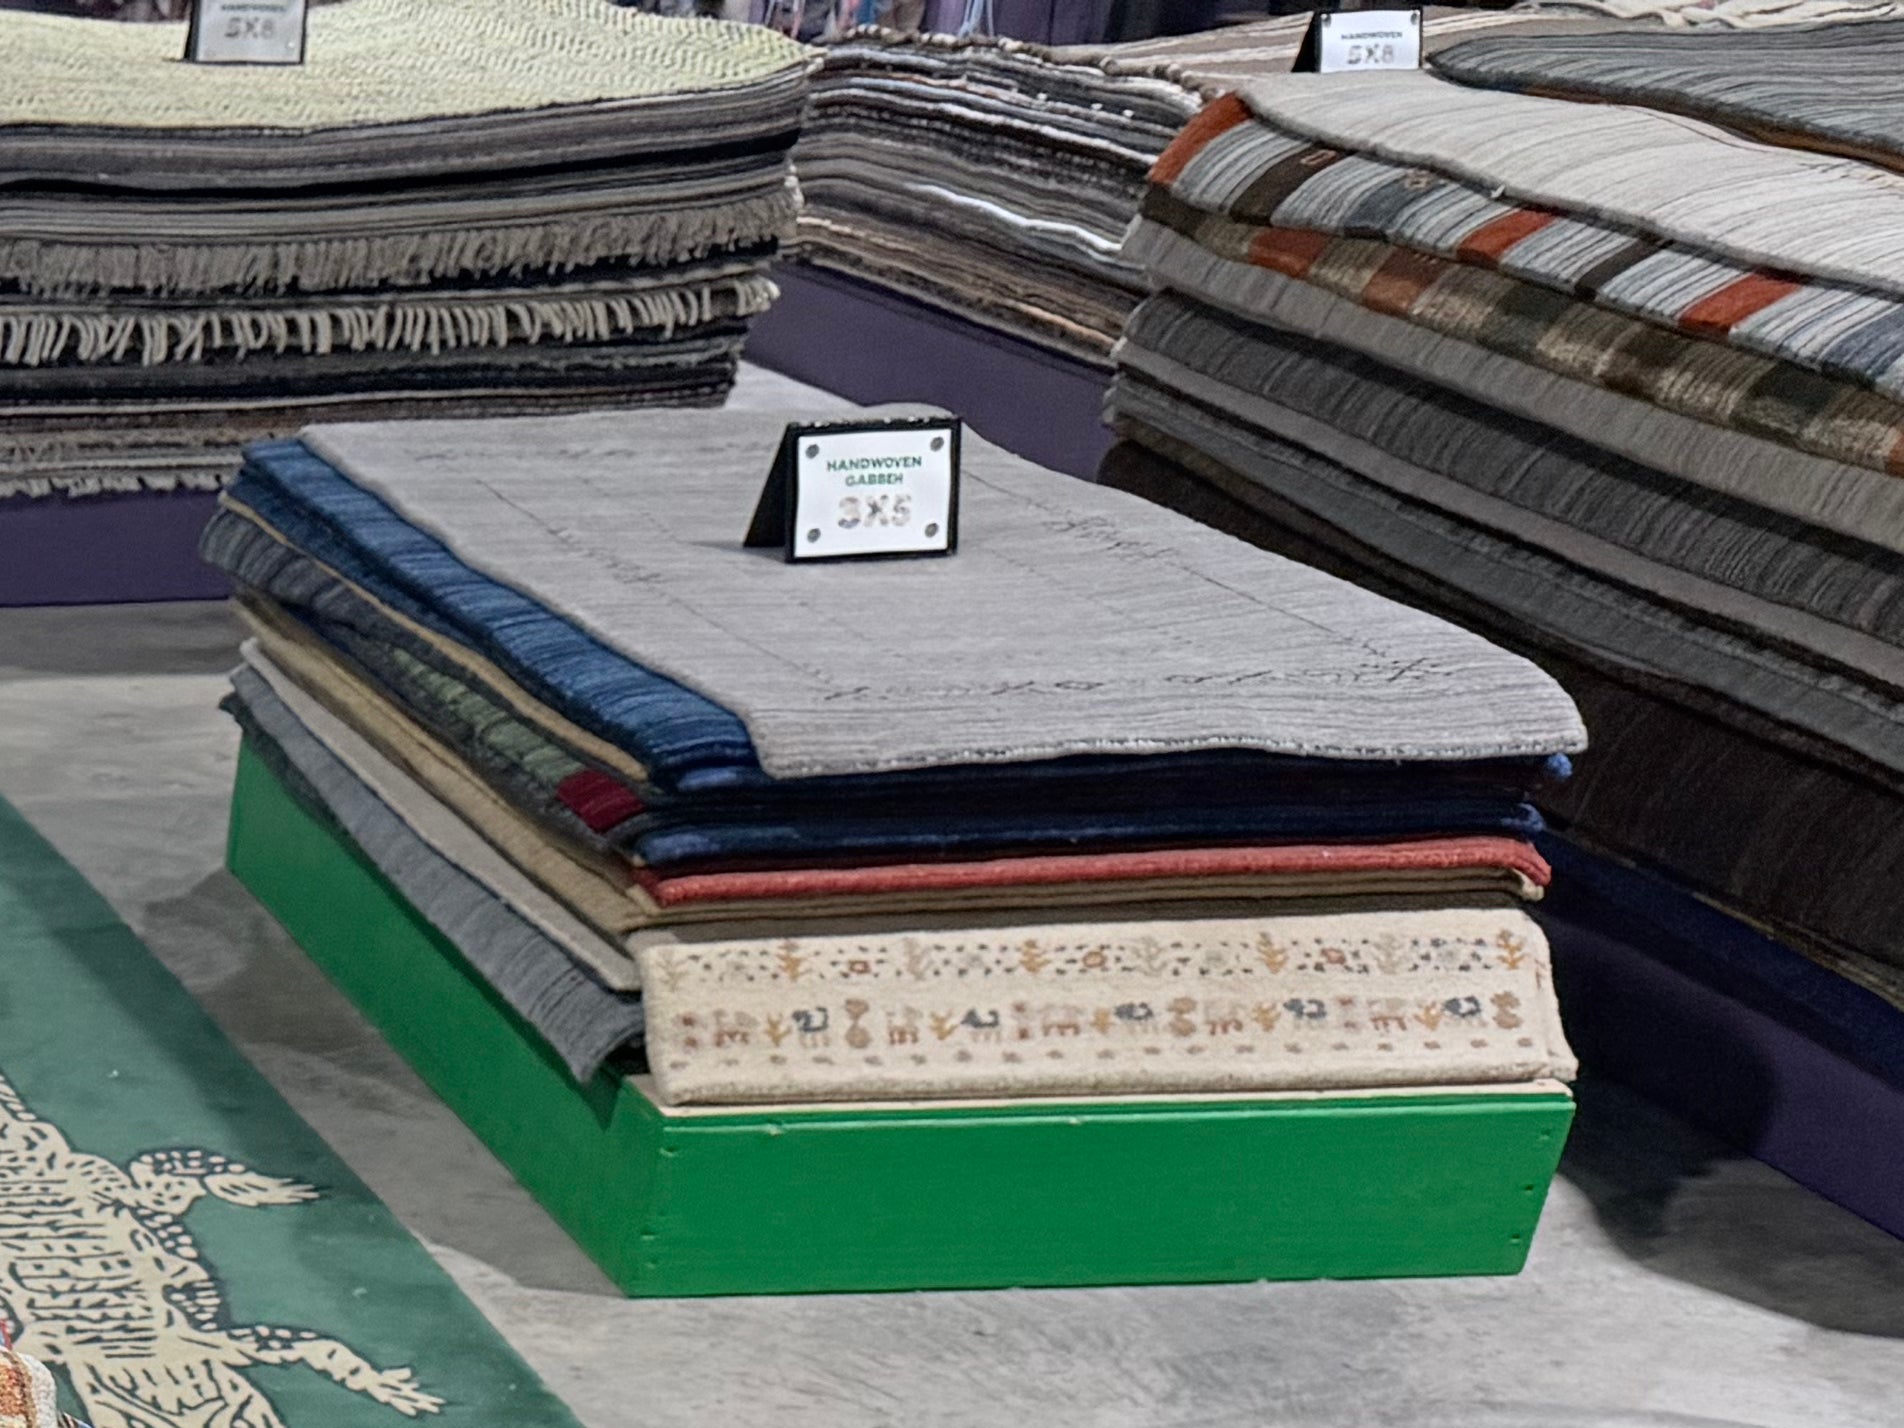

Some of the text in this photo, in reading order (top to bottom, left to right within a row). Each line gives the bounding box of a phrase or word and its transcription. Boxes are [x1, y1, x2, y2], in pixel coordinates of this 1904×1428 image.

[1347, 43, 1394, 65] 5X8
[826, 456, 922, 472] HANDWOVEN
[845, 473, 903, 487] GABBEH
[837, 494, 911, 529] 3X5
